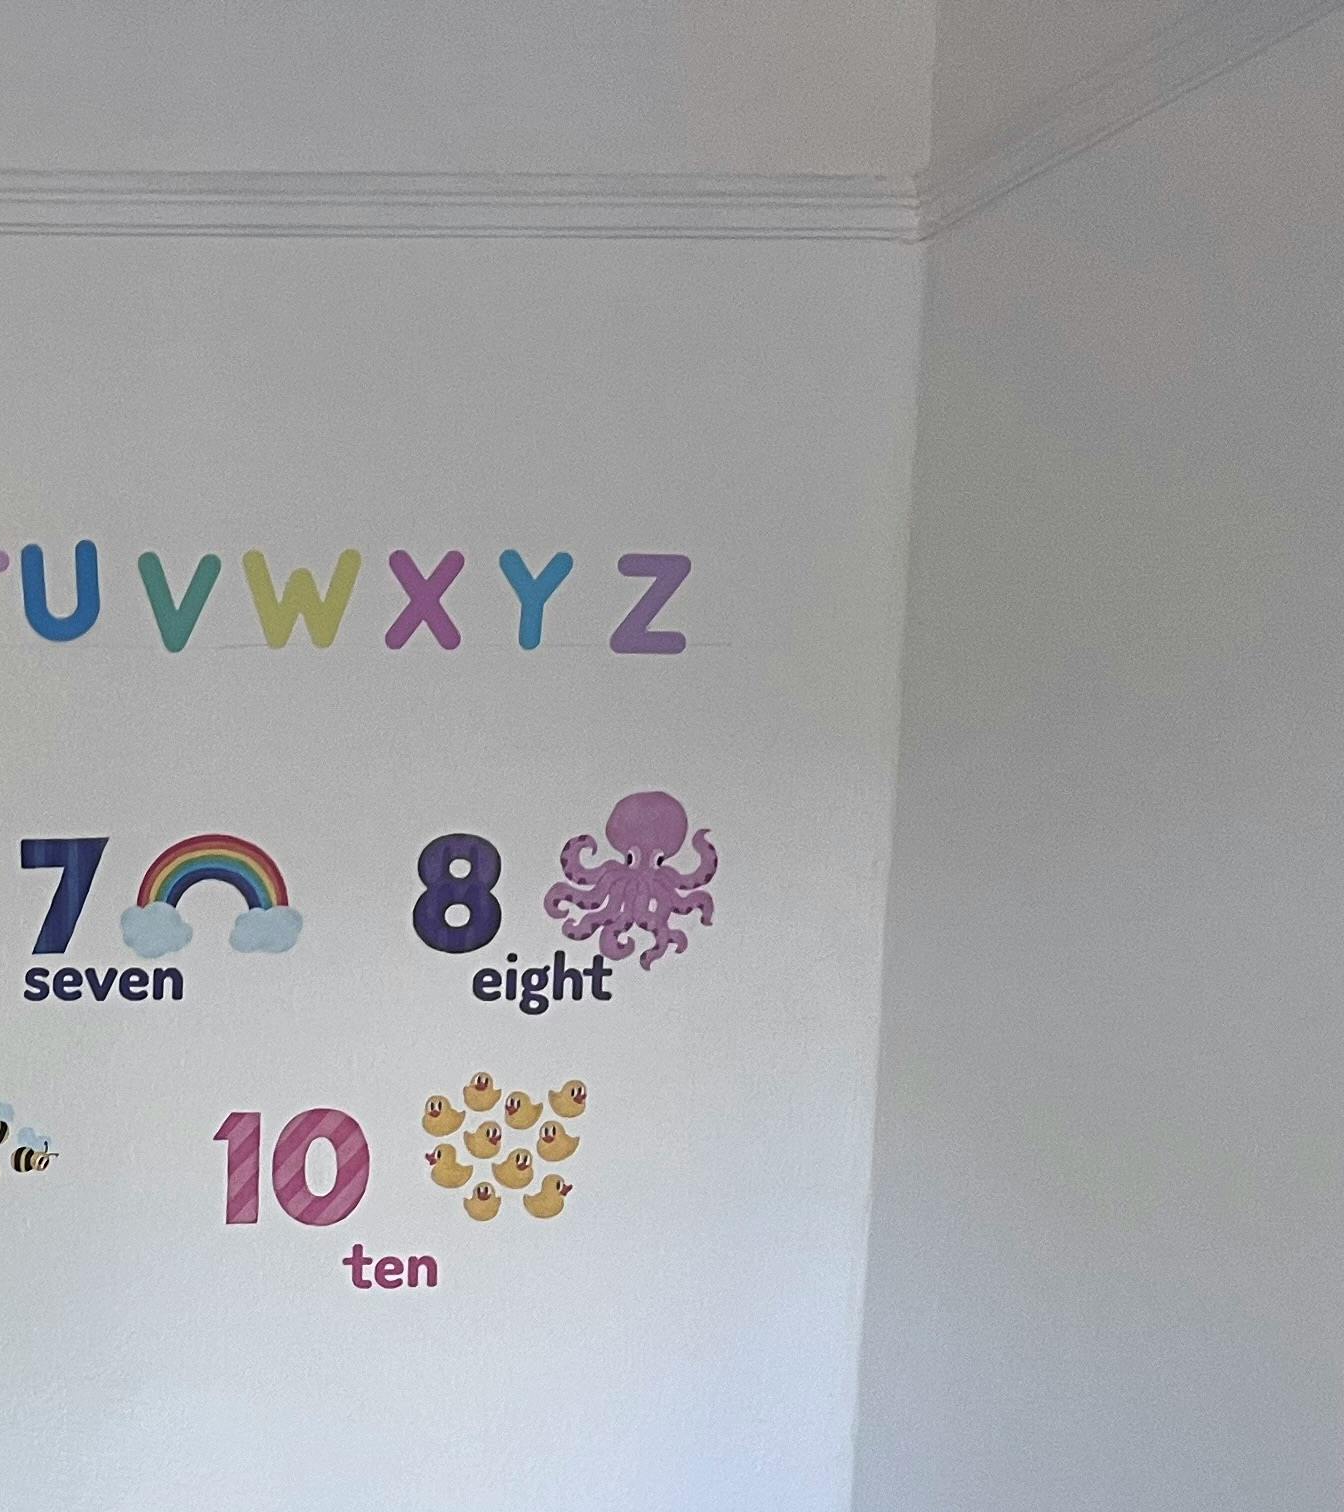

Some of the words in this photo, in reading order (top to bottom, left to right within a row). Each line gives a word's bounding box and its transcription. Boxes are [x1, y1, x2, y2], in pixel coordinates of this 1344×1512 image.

[20, 539, 101, 642] U
[138, 551, 222, 653] V
[242, 548, 362, 649] W
[385, 549, 466, 651] X
[498, 549, 574, 650] Y
[610, 553, 692, 654] Z
[20, 837, 110, 955] 7
[412, 833, 502, 954] 8
[23, 967, 185, 1002] seven
[471, 950, 613, 1016] eight
[213, 1108, 370, 1227] 10
[343, 1244, 438, 1290] ten
